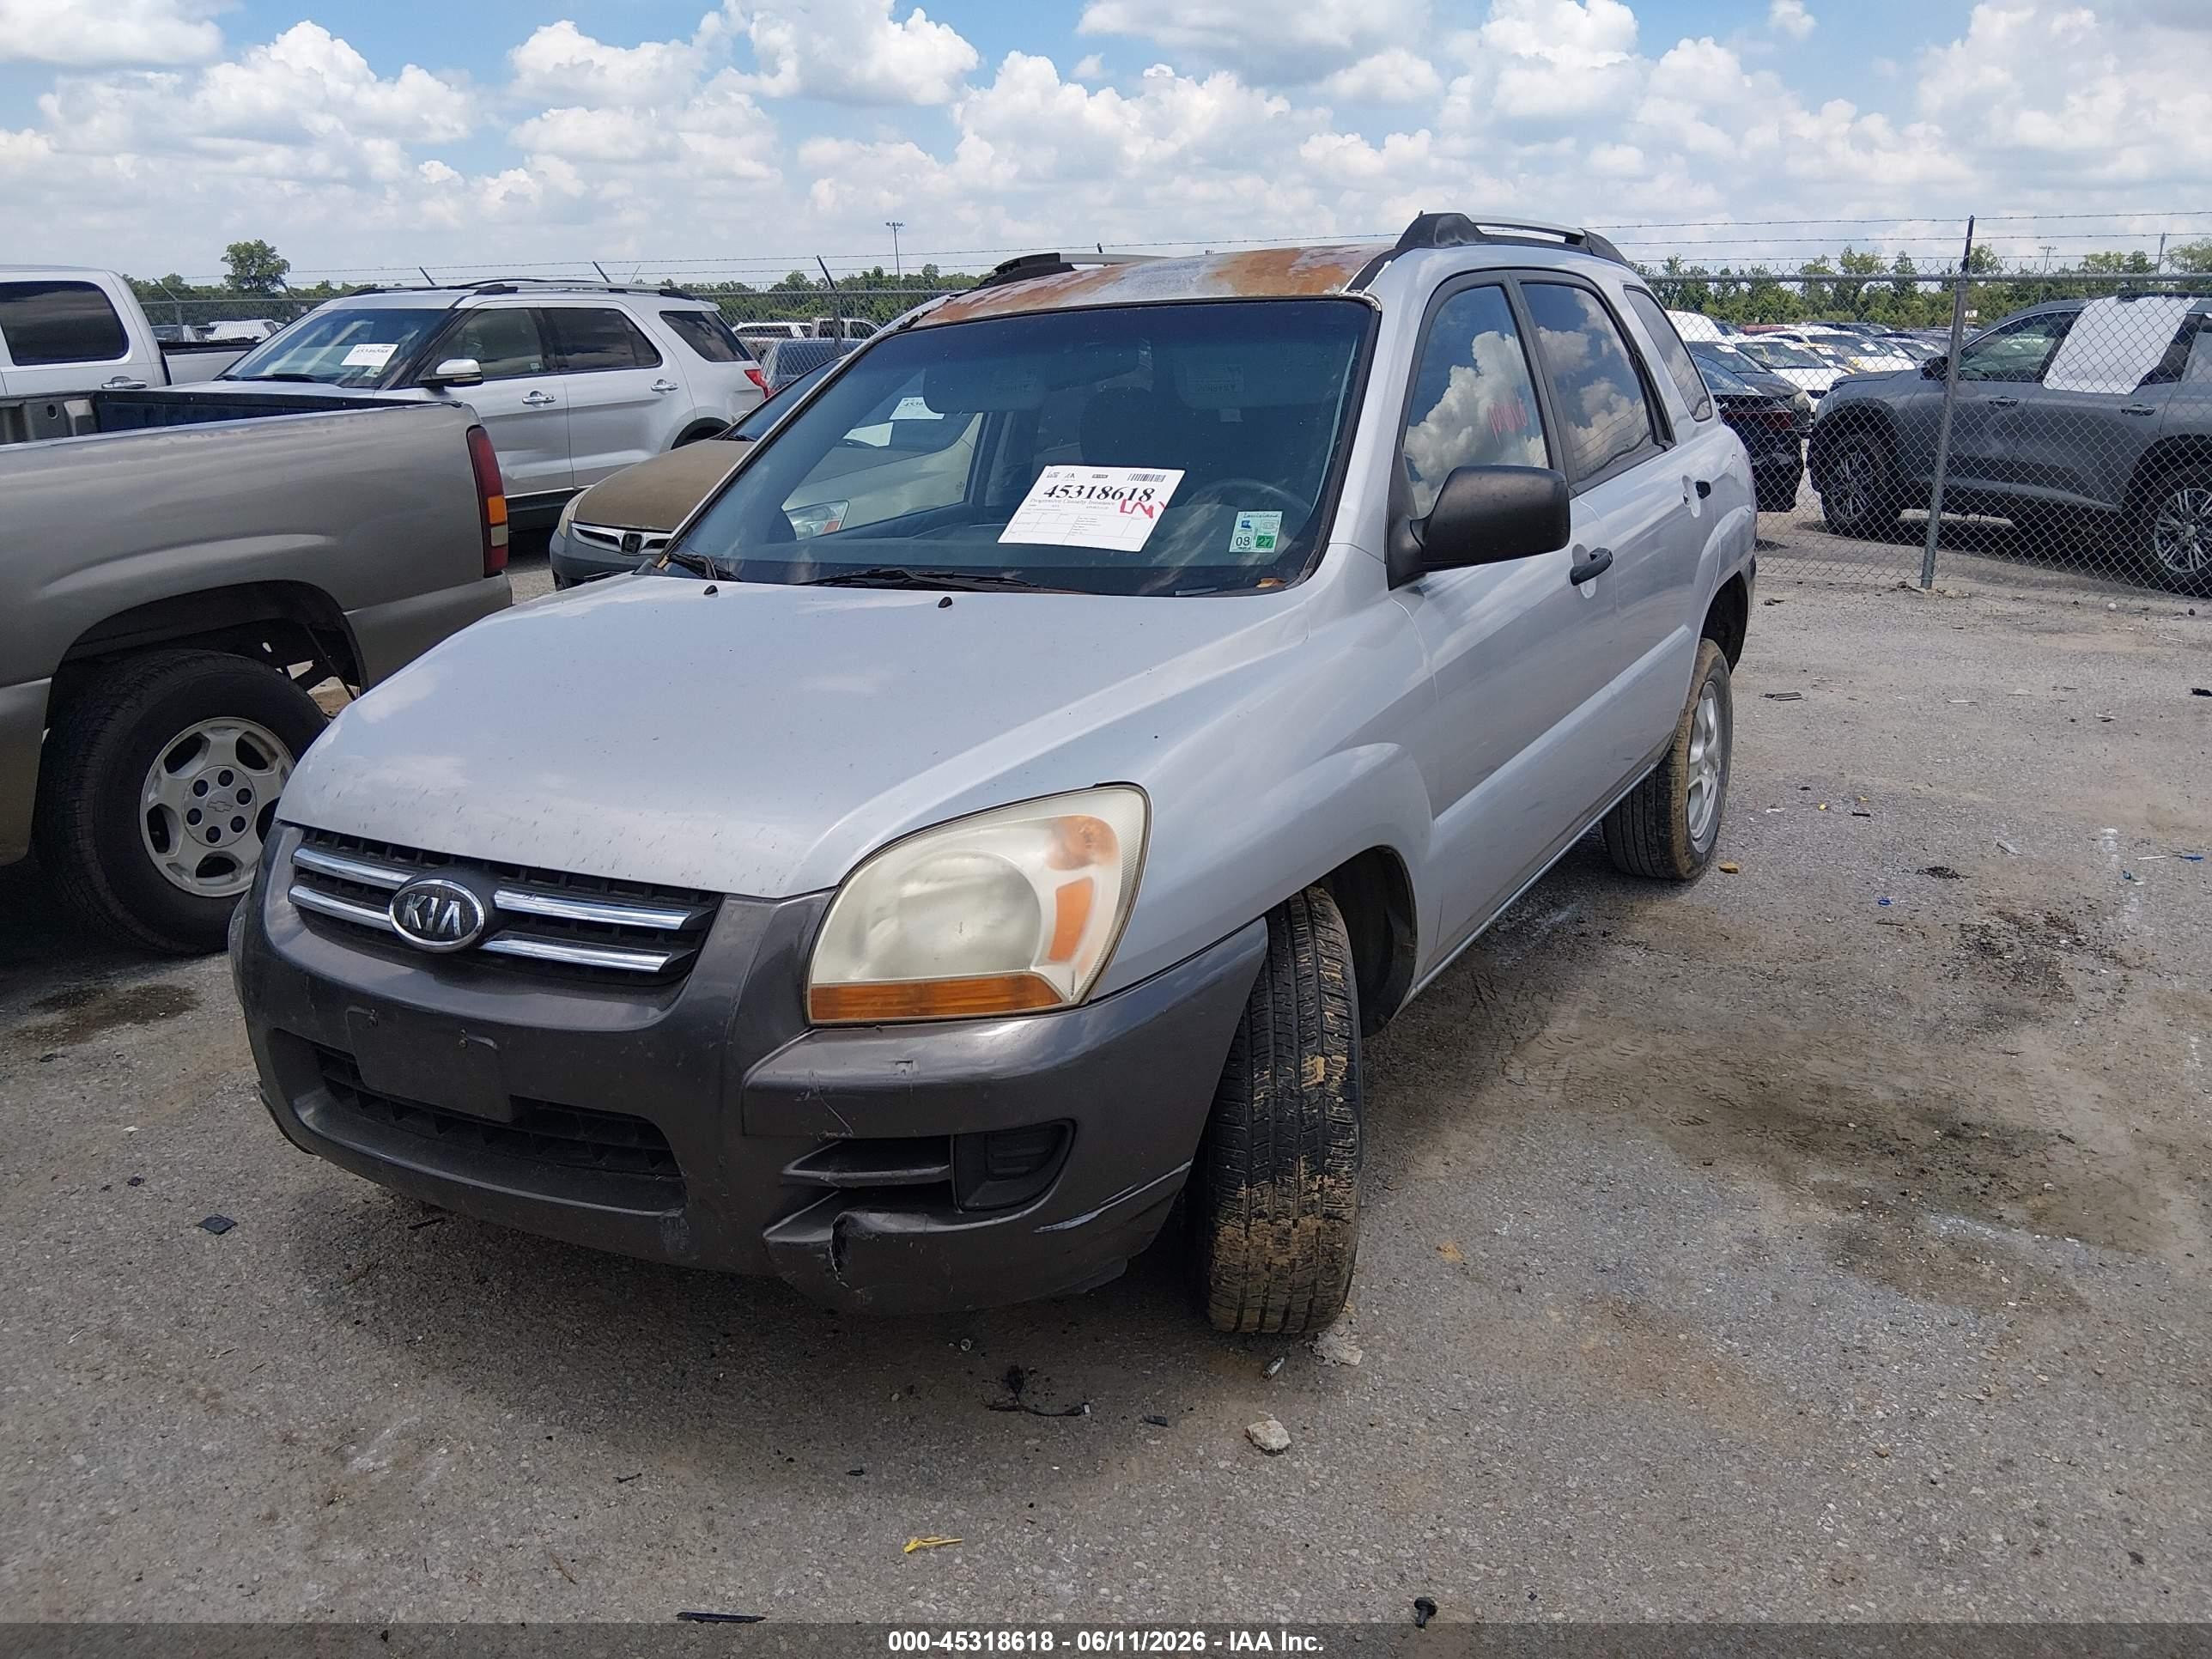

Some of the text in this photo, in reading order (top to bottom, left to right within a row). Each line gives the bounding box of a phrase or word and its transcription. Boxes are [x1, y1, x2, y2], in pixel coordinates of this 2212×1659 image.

[1043, 484, 1155, 502] 45318618
[1236, 536, 1273, 547] 08 27
[402, 893, 461, 936] KIA
